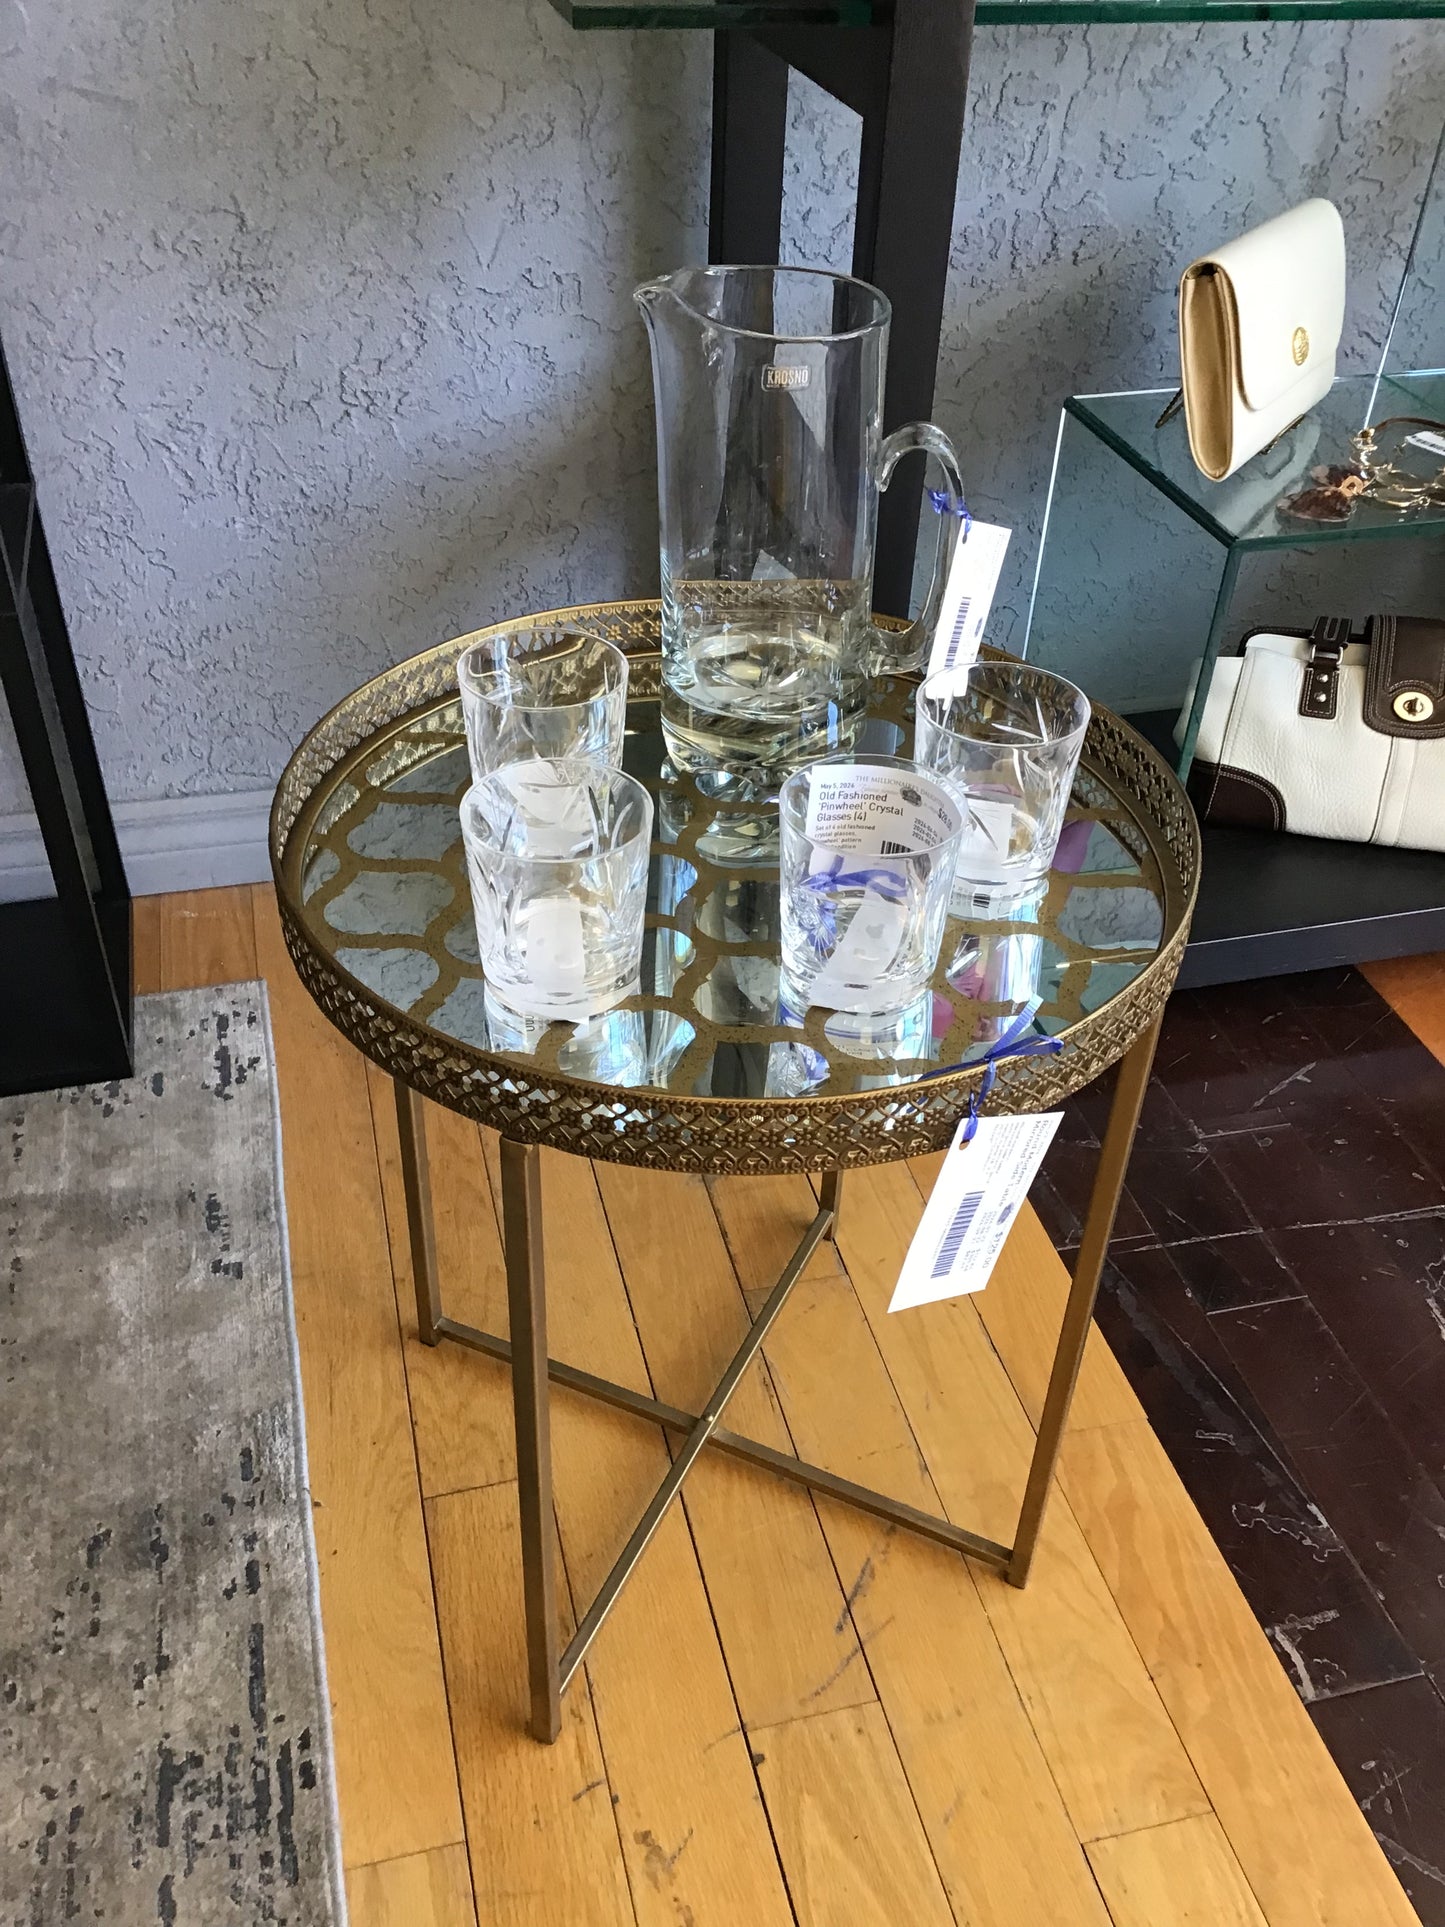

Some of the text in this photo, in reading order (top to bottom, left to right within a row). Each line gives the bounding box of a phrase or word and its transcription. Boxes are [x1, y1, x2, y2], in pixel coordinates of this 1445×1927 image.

[767, 370, 809, 384] KROSNO
[819, 791, 836, 800] Old
[838, 791, 888, 802] Fashioned
[817, 811, 867, 822] Glasses (4)
[869, 802, 904, 816] Crystal
[1019, 1120, 1041, 1158] Mirrored
[1030, 1119, 1049, 1149] Round
[1014, 1151, 1034, 1185] Modern
[980, 1231, 1004, 1268] $125.00
